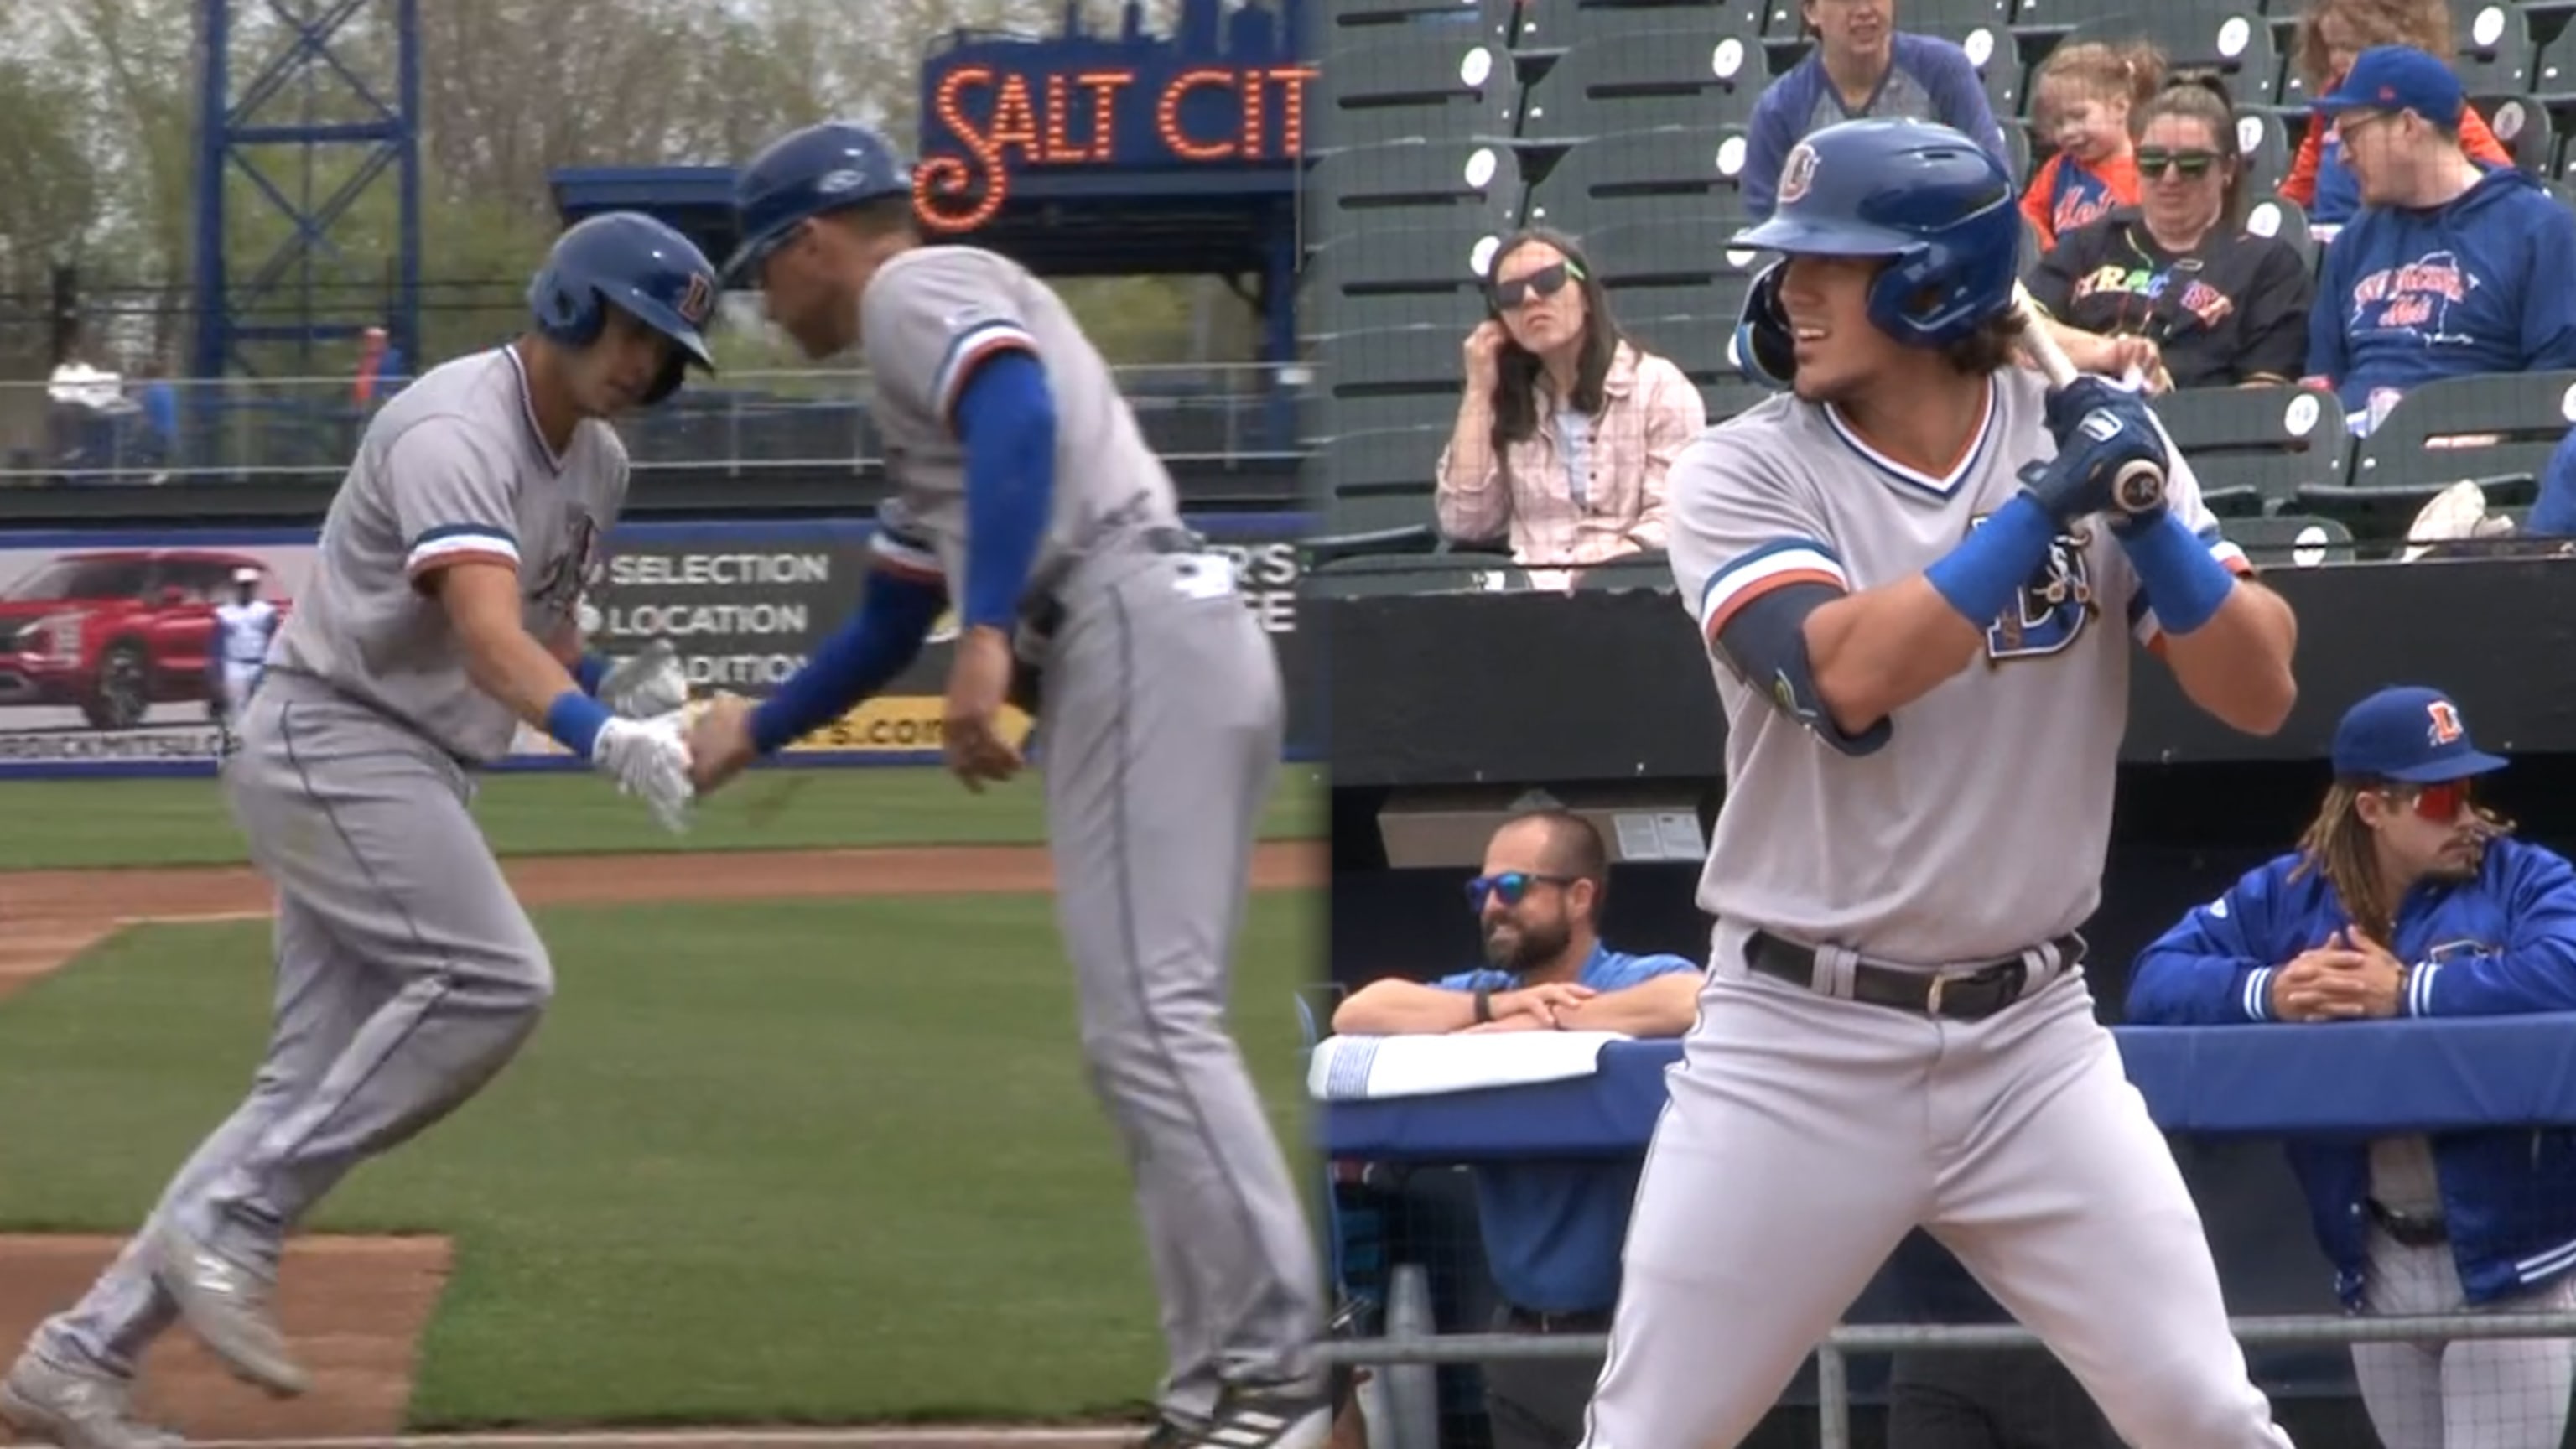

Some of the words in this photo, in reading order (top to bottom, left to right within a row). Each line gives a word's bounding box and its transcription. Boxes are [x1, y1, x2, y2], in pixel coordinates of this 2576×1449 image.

[911, 63, 1135, 232] SALT
[610, 553, 829, 585] SELECTION
[609, 604, 808, 636] LOCATION
